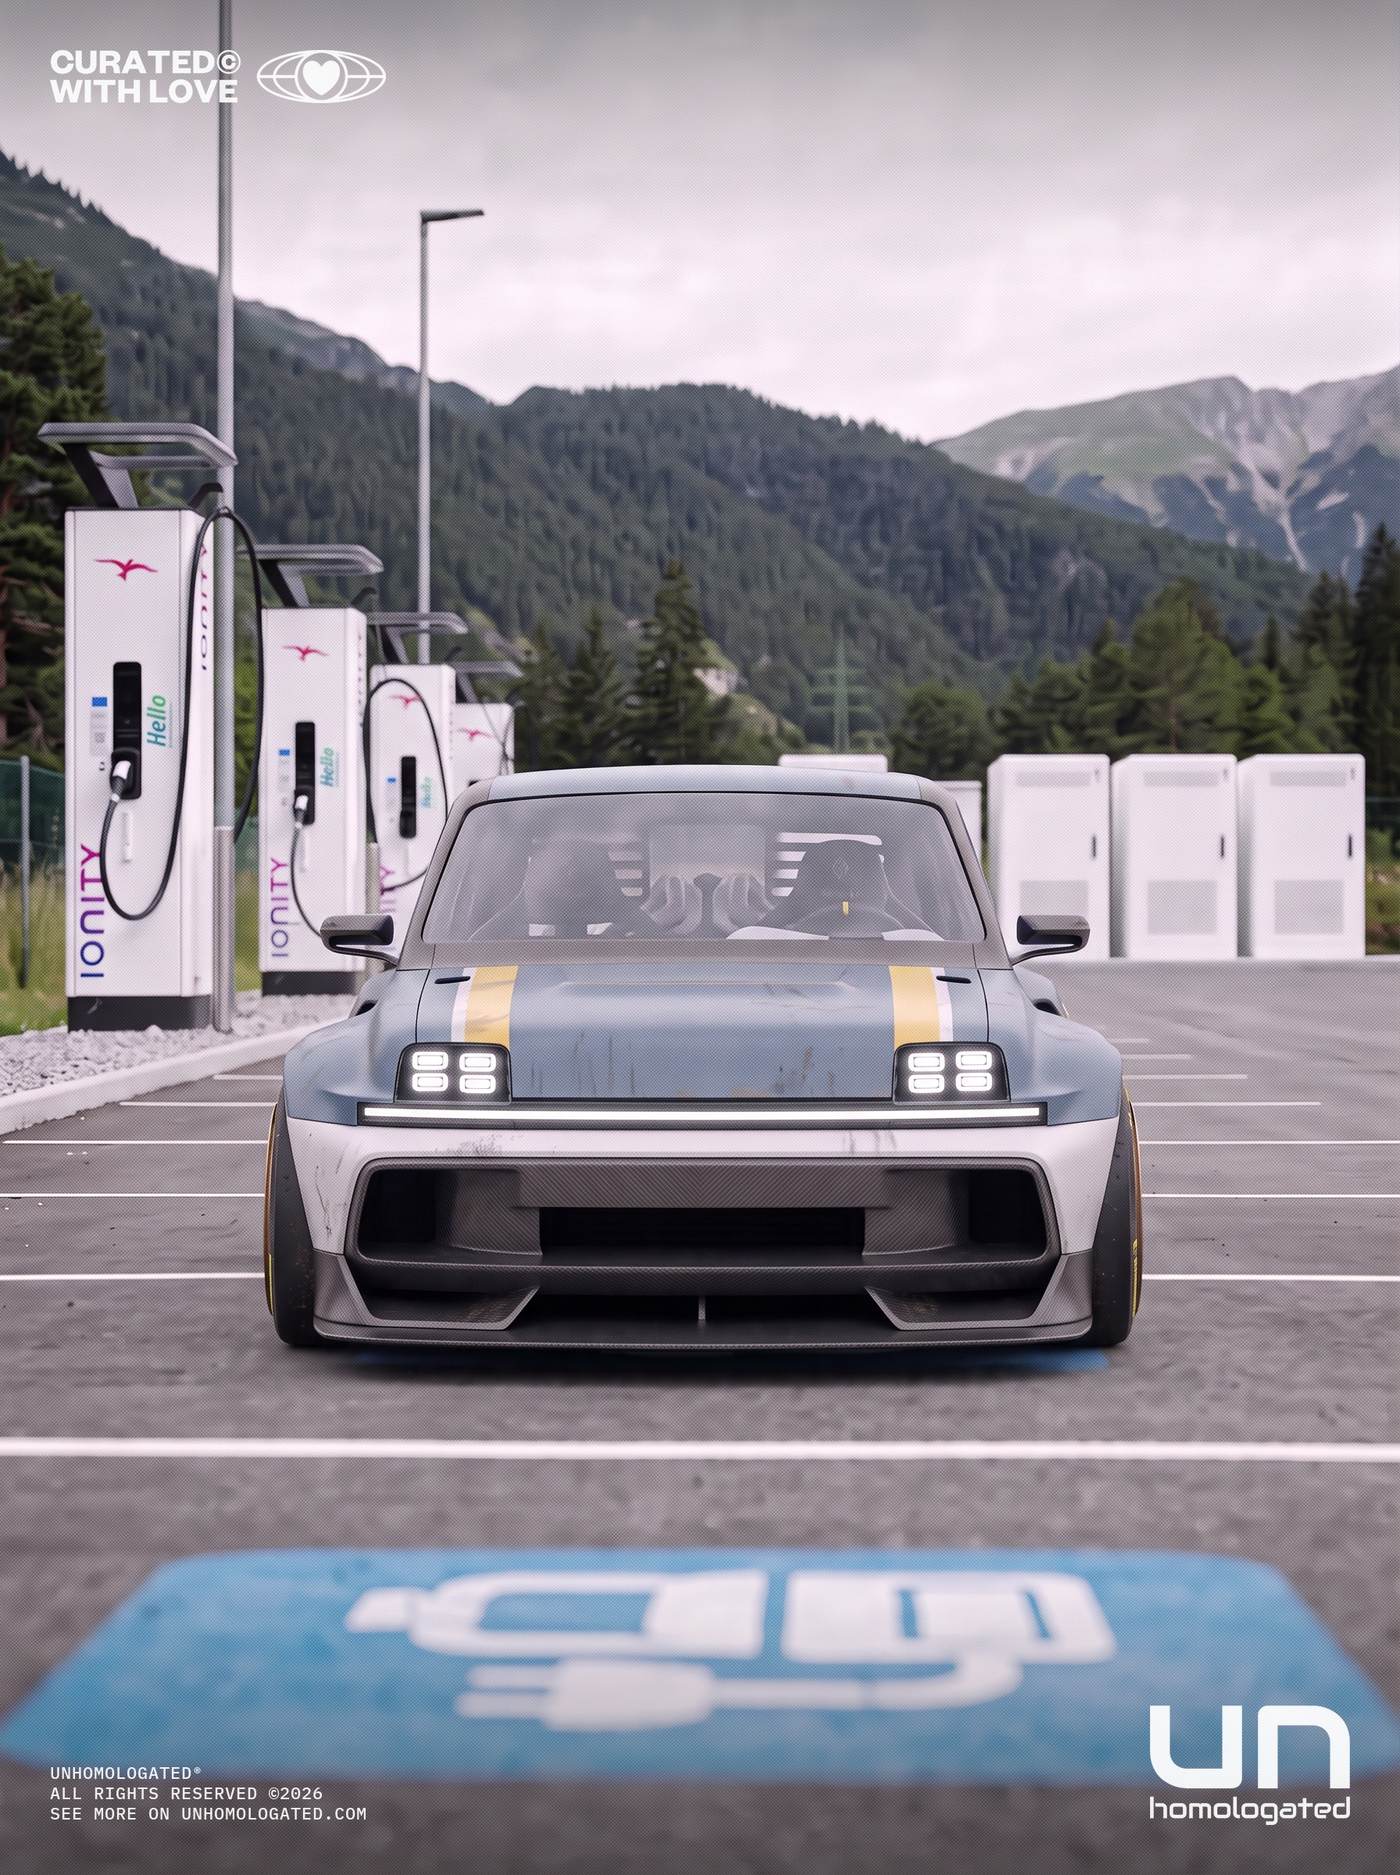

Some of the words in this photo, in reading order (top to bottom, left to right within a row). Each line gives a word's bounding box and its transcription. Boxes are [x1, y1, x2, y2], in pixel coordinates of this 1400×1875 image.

[146, 694, 166, 747] Hello
[320, 748, 335, 787] Hello
[79, 843, 105, 978] IONITY
[270, 857, 289, 957] IONITY
